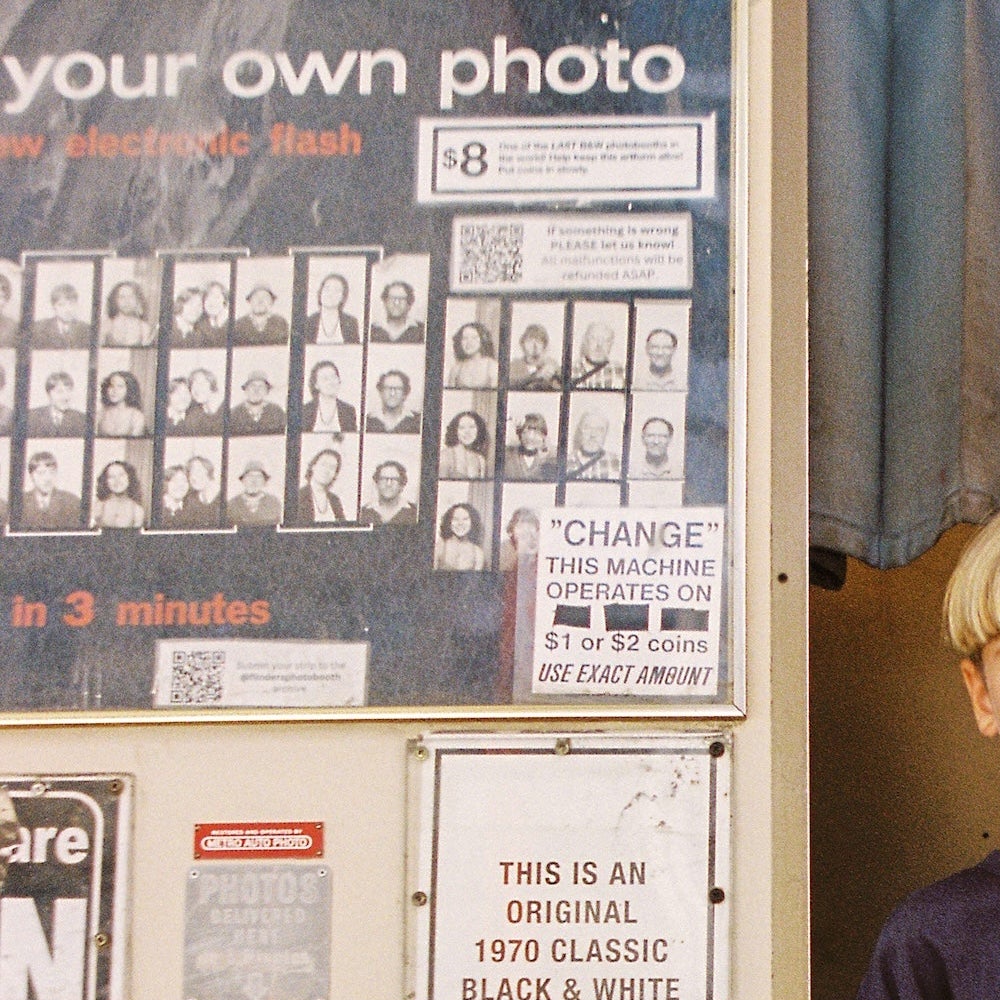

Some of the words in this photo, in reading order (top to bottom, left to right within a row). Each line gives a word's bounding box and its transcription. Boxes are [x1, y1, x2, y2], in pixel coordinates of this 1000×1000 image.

[1, 51, 197, 115] your
[222, 49, 407, 98] own
[440, 35, 686, 109] photo
[270, 122, 362, 157] flash
[442, 141, 489, 177] $8
[559, 225, 625, 237] something
[627, 225, 637, 235] is
[640, 226, 679, 237] wrong
[550, 241, 597, 250] PLEASE
[601, 240, 617, 249] let
[621, 241, 635, 250] us
[560, 254, 640, 266] malfunctions
[644, 254, 665, 265] will
[668, 254, 684, 265] be
[562, 269, 619, 281] refunded
[546, 556, 598, 575] THIS
[607, 558, 716, 577] MACHINE
[546, 582, 669, 602] OPERATES
[678, 584, 712, 602] ON
[11, 594, 47, 628] in
[63, 590, 95, 628] 3
[116, 592, 271, 627] minutes
[545, 631, 571, 651] $1
[581, 637, 604, 651] or
[611, 633, 640, 653] $2
[648, 635, 708, 653] coins
[538, 663, 574, 682] USE
[576, 663, 635, 684] EXACT
[636, 665, 713, 686] AMOUNT
[206, 838, 243, 848] METRO
[244, 838, 271, 848] AUTO
[273, 837, 308, 847] PHOTO
[499, 861, 561, 885] THIS
[573, 861, 598, 885] IS
[609, 861, 646, 885] AN
[199, 872, 320, 904] PHOTOS
[507, 900, 638, 924] ORIGINAL
[475, 939, 540, 963] 1970
[551, 938, 668, 963] CLASSIC
[563, 977, 581, 1000] &
[593, 977, 680, 1000] WHITE
